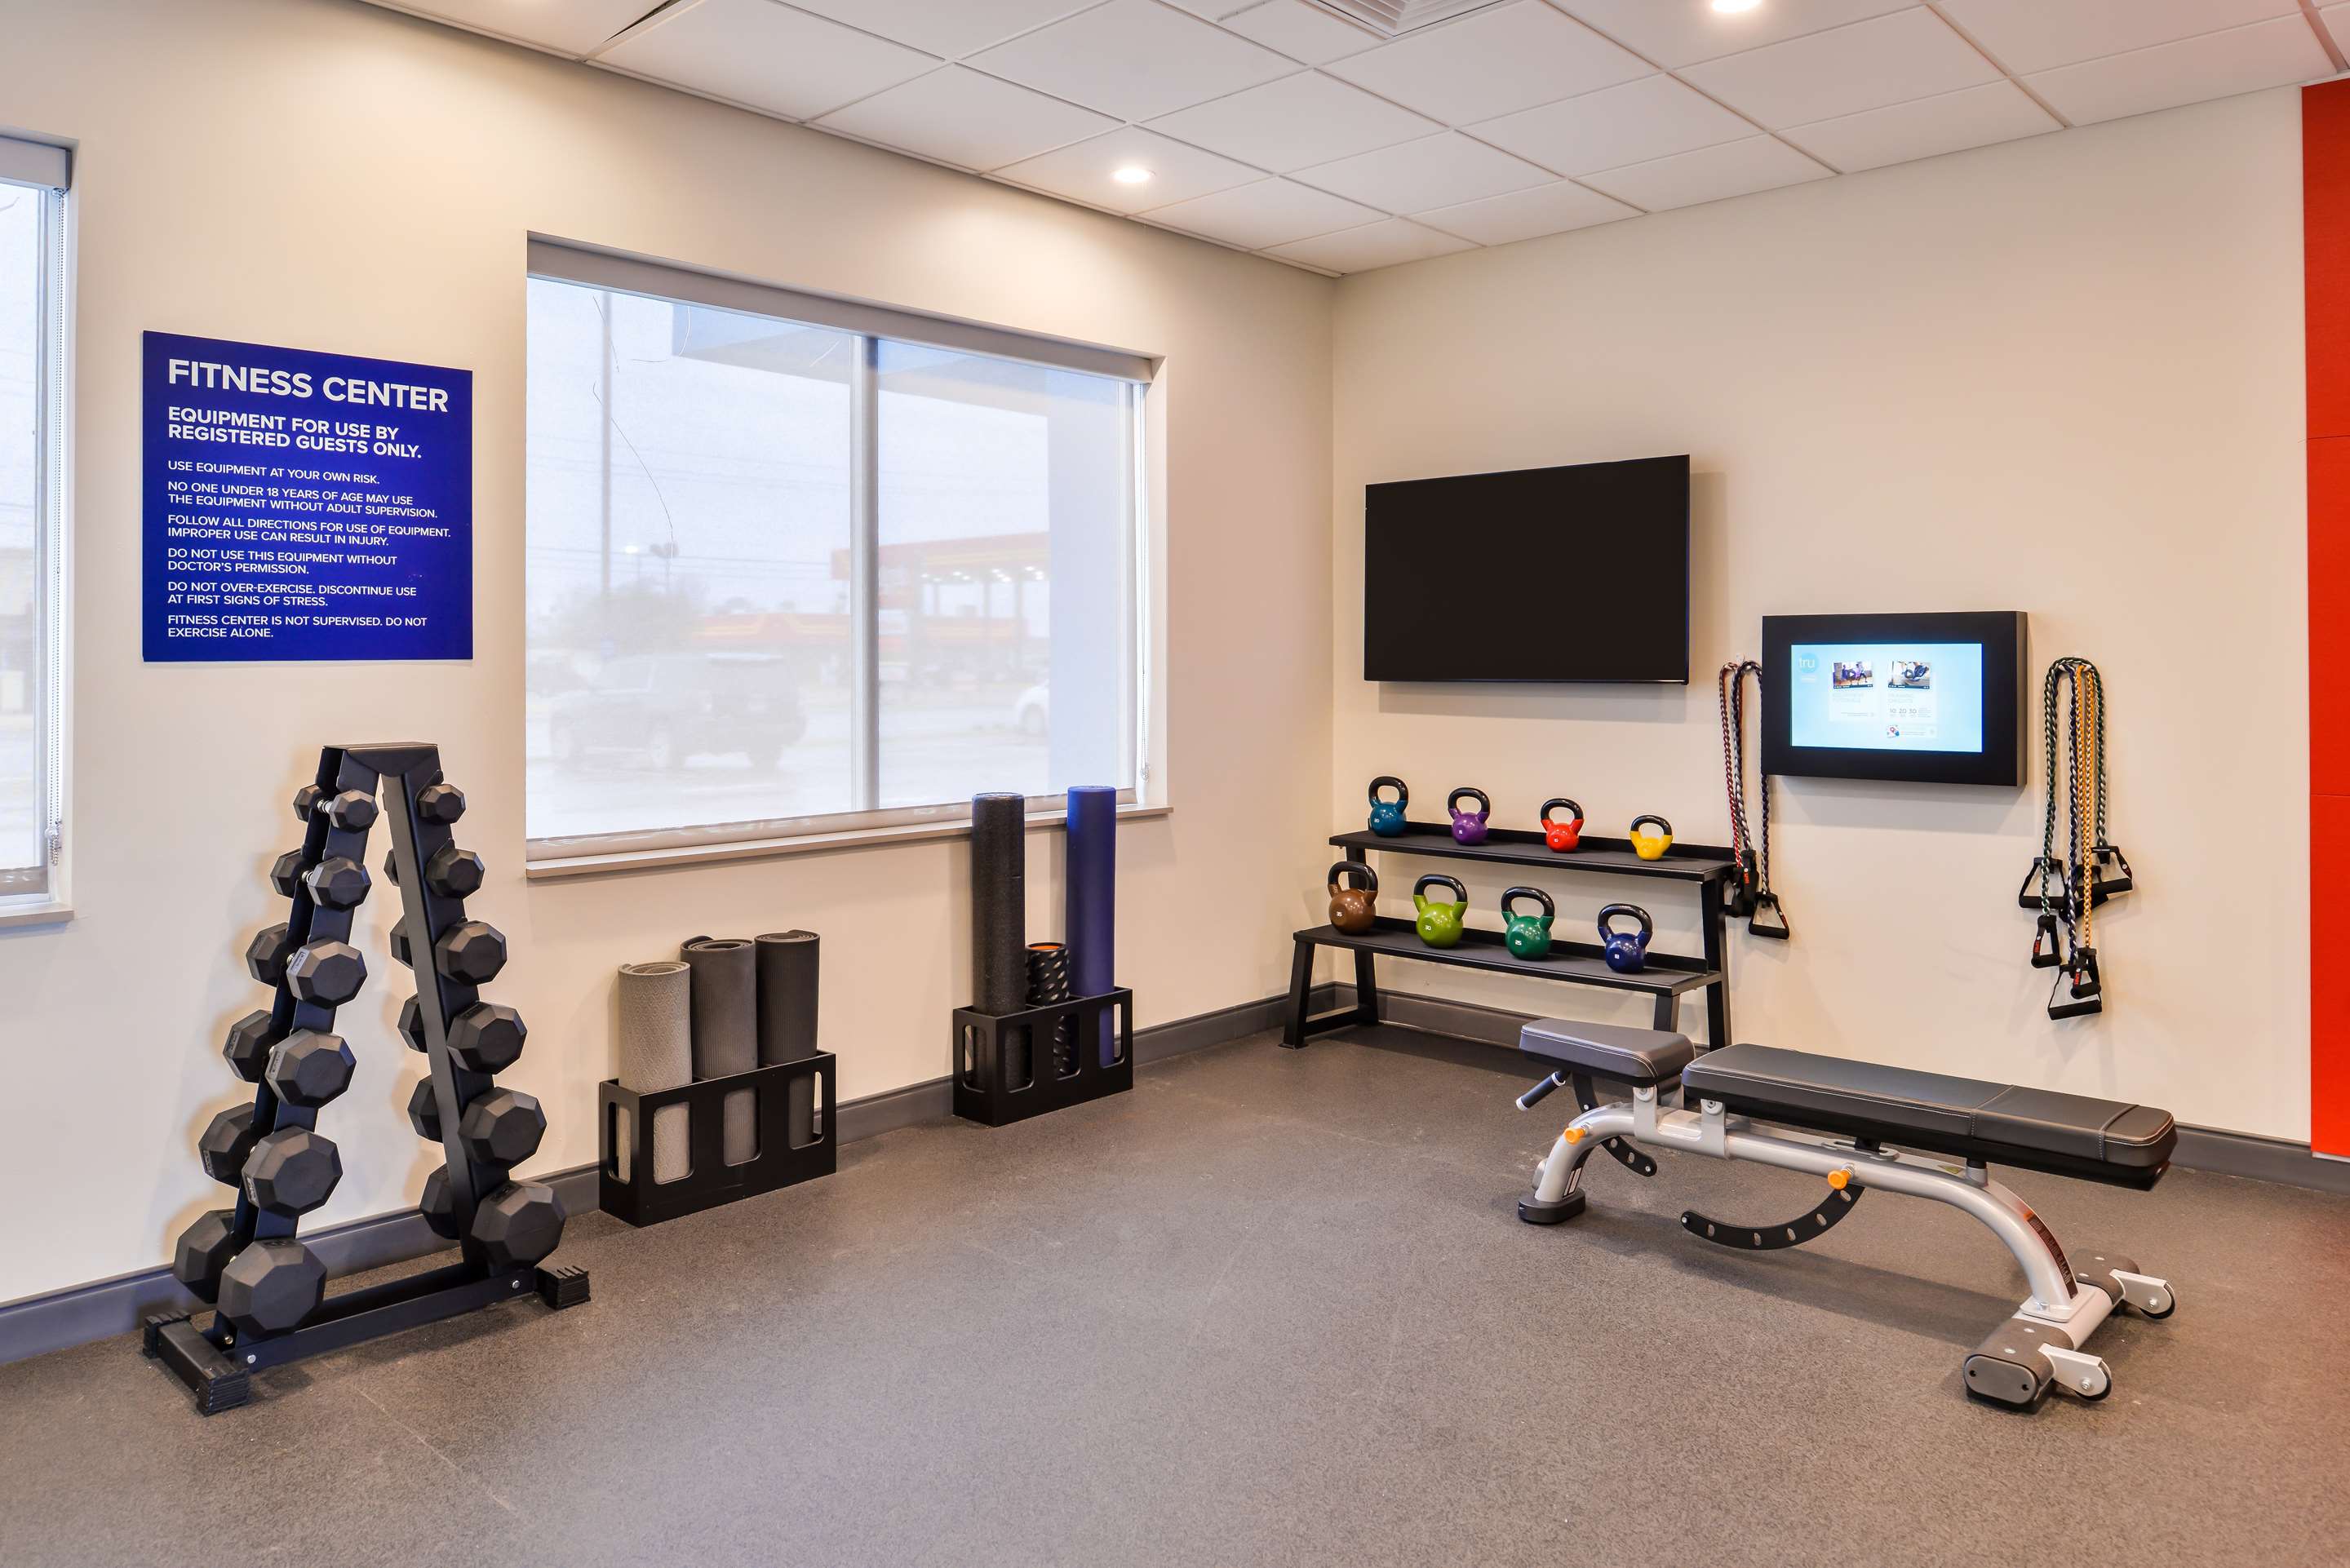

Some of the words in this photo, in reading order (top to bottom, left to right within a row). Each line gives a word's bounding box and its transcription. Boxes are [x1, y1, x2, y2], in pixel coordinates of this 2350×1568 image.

[169, 359, 313, 398] FITNESS
[323, 377, 448, 412] CENTER
[169, 406, 286, 430] EQUIPMENT
[292, 418, 330, 435] FOR
[335, 422, 370, 438] USE
[376, 426, 399, 441] BY
[169, 423, 290, 447] REGISTERED
[295, 435, 368, 454] GUESTS
[373, 441, 422, 458] ONLY.
[168, 460, 193, 471] USE
[197, 463, 268, 476] EQUIPMENT
[269, 467, 285, 477] AT
[287, 468, 320, 480] YOUR
[322, 472, 350, 482] OWN
[353, 473, 379, 485] RISK.
[168, 481, 188, 491] NO
[191, 482, 218, 494] ONE
[221, 485, 264, 496] UNDER
[267, 487, 279, 497] 18
[282, 488, 319, 499] YEARS
[321, 491, 338, 500] OF
[340, 492, 363, 502] AGE
[366, 494, 389, 503] MAY
[392, 495, 413, 505] USE
[168, 494, 193, 504] THE
[196, 495, 267, 508] EQUIPMENT
[269, 499, 324, 512] WITHOUT
[326, 503, 362, 514] ADULT
[365, 505, 437, 518] SUPERVISION.
[168, 514, 219, 526] FOLLOW
[223, 517, 245, 527] ALL
[247, 518, 317, 531] DIRECTIONS
[320, 522, 344, 532] FOR
[346, 523, 368, 534] USE
[370, 525, 386, 534] OF
[388, 525, 450, 537] EQUIPMENT.
[168, 527, 231, 539] IMPROPER
[234, 530, 258, 540] USE
[261, 531, 286, 542] CAN
[290, 533, 331, 543] RESULT
[335, 534, 346, 544] IN
[348, 535, 389, 546] INJURY.
[168, 547, 188, 558] DO
[191, 549, 218, 559] NOT
[221, 550, 245, 560] USE
[247, 551, 274, 560] THIS
[277, 551, 344, 563] EQUIPMENT
[347, 555, 397, 565] WITHOUT
[168, 560, 232, 572] DOCTOR'S
[235, 563, 309, 574] PERMISSION.
[168, 582, 188, 591] DO
[191, 582, 218, 591] NOT
[220, 582, 316, 594] OVER-EXERCISE.
[318, 585, 392, 596] DISCONTINUE
[396, 587, 416, 596] USE
[167, 594, 184, 604] AT
[187, 595, 220, 605] FIRST
[224, 595, 260, 605] SIGNS
[264, 596, 280, 605] OF
[283, 596, 328, 606] STRESS.
[168, 615, 218, 625] FITNESS
[221, 615, 268, 625] CENTER
[272, 616, 282, 625] IS
[286, 616, 310, 625] NOT
[313, 616, 383, 626] SUPERVISED.
[386, 617, 402, 626] DO
[405, 618, 428, 627] NOT
[168, 627, 227, 637] EXERCISE
[230, 627, 273, 638] ALONE.
[1798, 657, 1816, 668] tru
